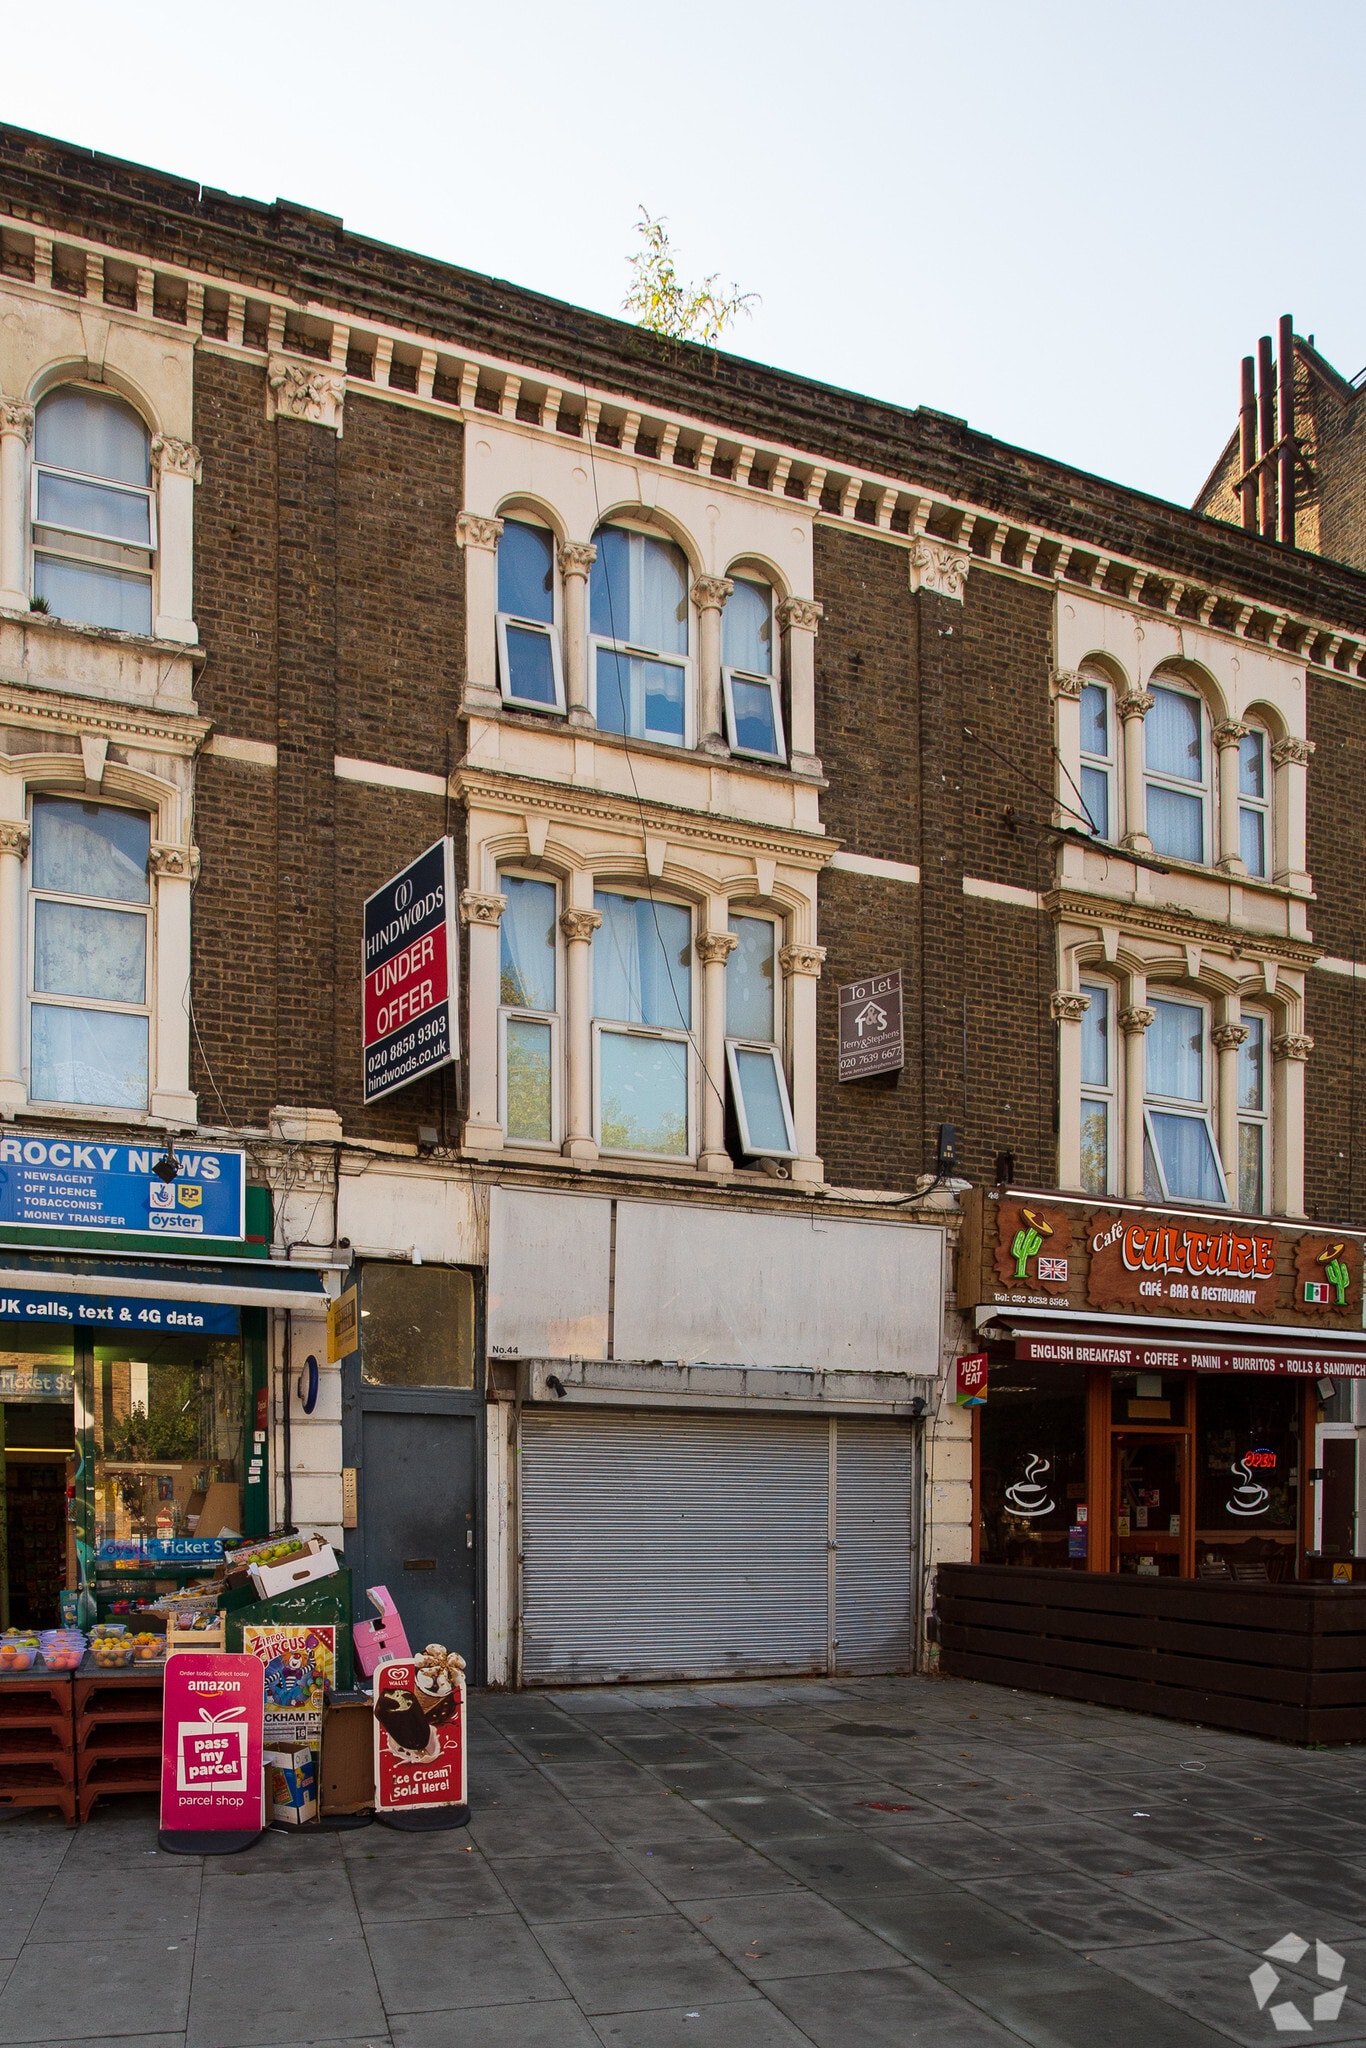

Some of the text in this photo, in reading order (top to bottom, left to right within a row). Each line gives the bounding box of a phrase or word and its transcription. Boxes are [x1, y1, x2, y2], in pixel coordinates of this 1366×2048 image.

[366, 885, 444, 960] HINDWOODS
[375, 936, 434, 996] UNDER
[849, 977, 892, 1001] To Let
[377, 979, 433, 1034] OFFER
[368, 1016, 446, 1073] 020 8858 9303
[368, 1039, 446, 1092] hindwoods.co.uk
[841, 1046, 901, 1069] 020 7639 6677
[0, 1139, 118, 1170] ROCKY
[24, 1171, 94, 1184] NEWSAGENT
[24, 1184, 97, 1198] OFF LICENCE
[24, 1197, 103, 1210] TOBACCONIST
[24, 1210, 125, 1225] MONEY TRANSFER
[151, 1213, 199, 1229] oyster
[1092, 1220, 1123, 1252] Café
[1122, 1225, 1275, 1279] CULTURE
[29, 1255, 65, 1264] Call
[69, 1254, 100, 1265] the
[104, 1259, 155, 1268] world
[187, 1264, 223, 1274] less
[1012, 1295, 1026, 1303] 020
[1139, 1280, 1162, 1297] CAFÉ
[1170, 1283, 1189, 1299] BAR
[1191, 1286, 1199, 1300] &
[1201, 1286, 1257, 1304] RESTAURANT
[26, 1302, 73, 1320] calls,
[79, 1305, 114, 1320] text
[118, 1307, 132, 1322] &
[138, 1309, 161, 1323] 4G
[166, 1311, 204, 1327] data
[492, 1345, 519, 1354] No.44
[961, 1359, 983, 1376] JUST
[1030, 1344, 1074, 1360] ENGLISH
[1076, 1347, 1131, 1363] BREAKFAST
[1143, 1351, 1178, 1366] COFFEE
[1191, 1354, 1221, 1369] PANINI
[1232, 1357, 1275, 1371] BURRITOS
[1286, 1359, 1312, 1374] ROLLS
[1315, 1361, 1322, 1374] &
[965, 1371, 983, 1386] EAT
[1245, 1451, 1277, 1468] OPEN
[161, 1539, 210, 1554] Ticket
[250, 1632, 286, 1652] ZIPPOS
[256, 1636, 306, 1669] CIRCUS
[188, 1680, 241, 1691] amazon
[264, 1713, 305, 1722] CKHAM
[296, 1728, 307, 1737] 18
[194, 1738, 229, 1753] pass
[200, 1751, 224, 1764] my
[189, 1760, 238, 1780] parcel
[413, 1768, 449, 1782] Cream
[393, 1779, 450, 1798] Sold Here!
[178, 1796, 244, 1807] parcel shop
